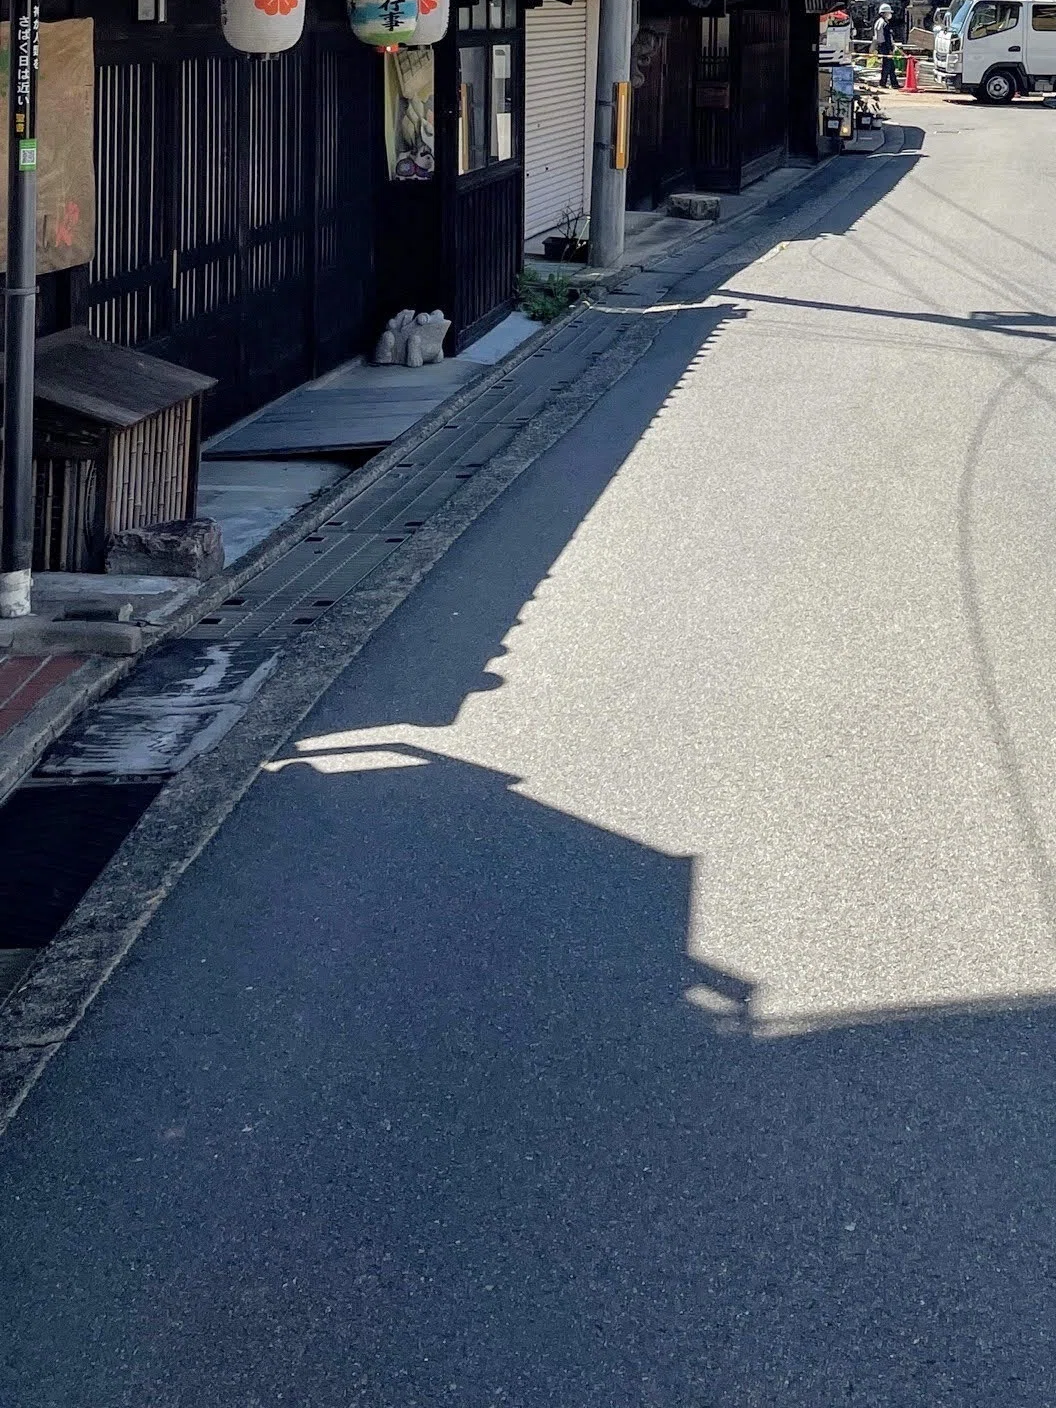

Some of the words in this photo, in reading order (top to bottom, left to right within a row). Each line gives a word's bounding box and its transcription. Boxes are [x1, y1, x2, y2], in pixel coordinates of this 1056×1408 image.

[17, 15, 31, 106] さばく日は近い
